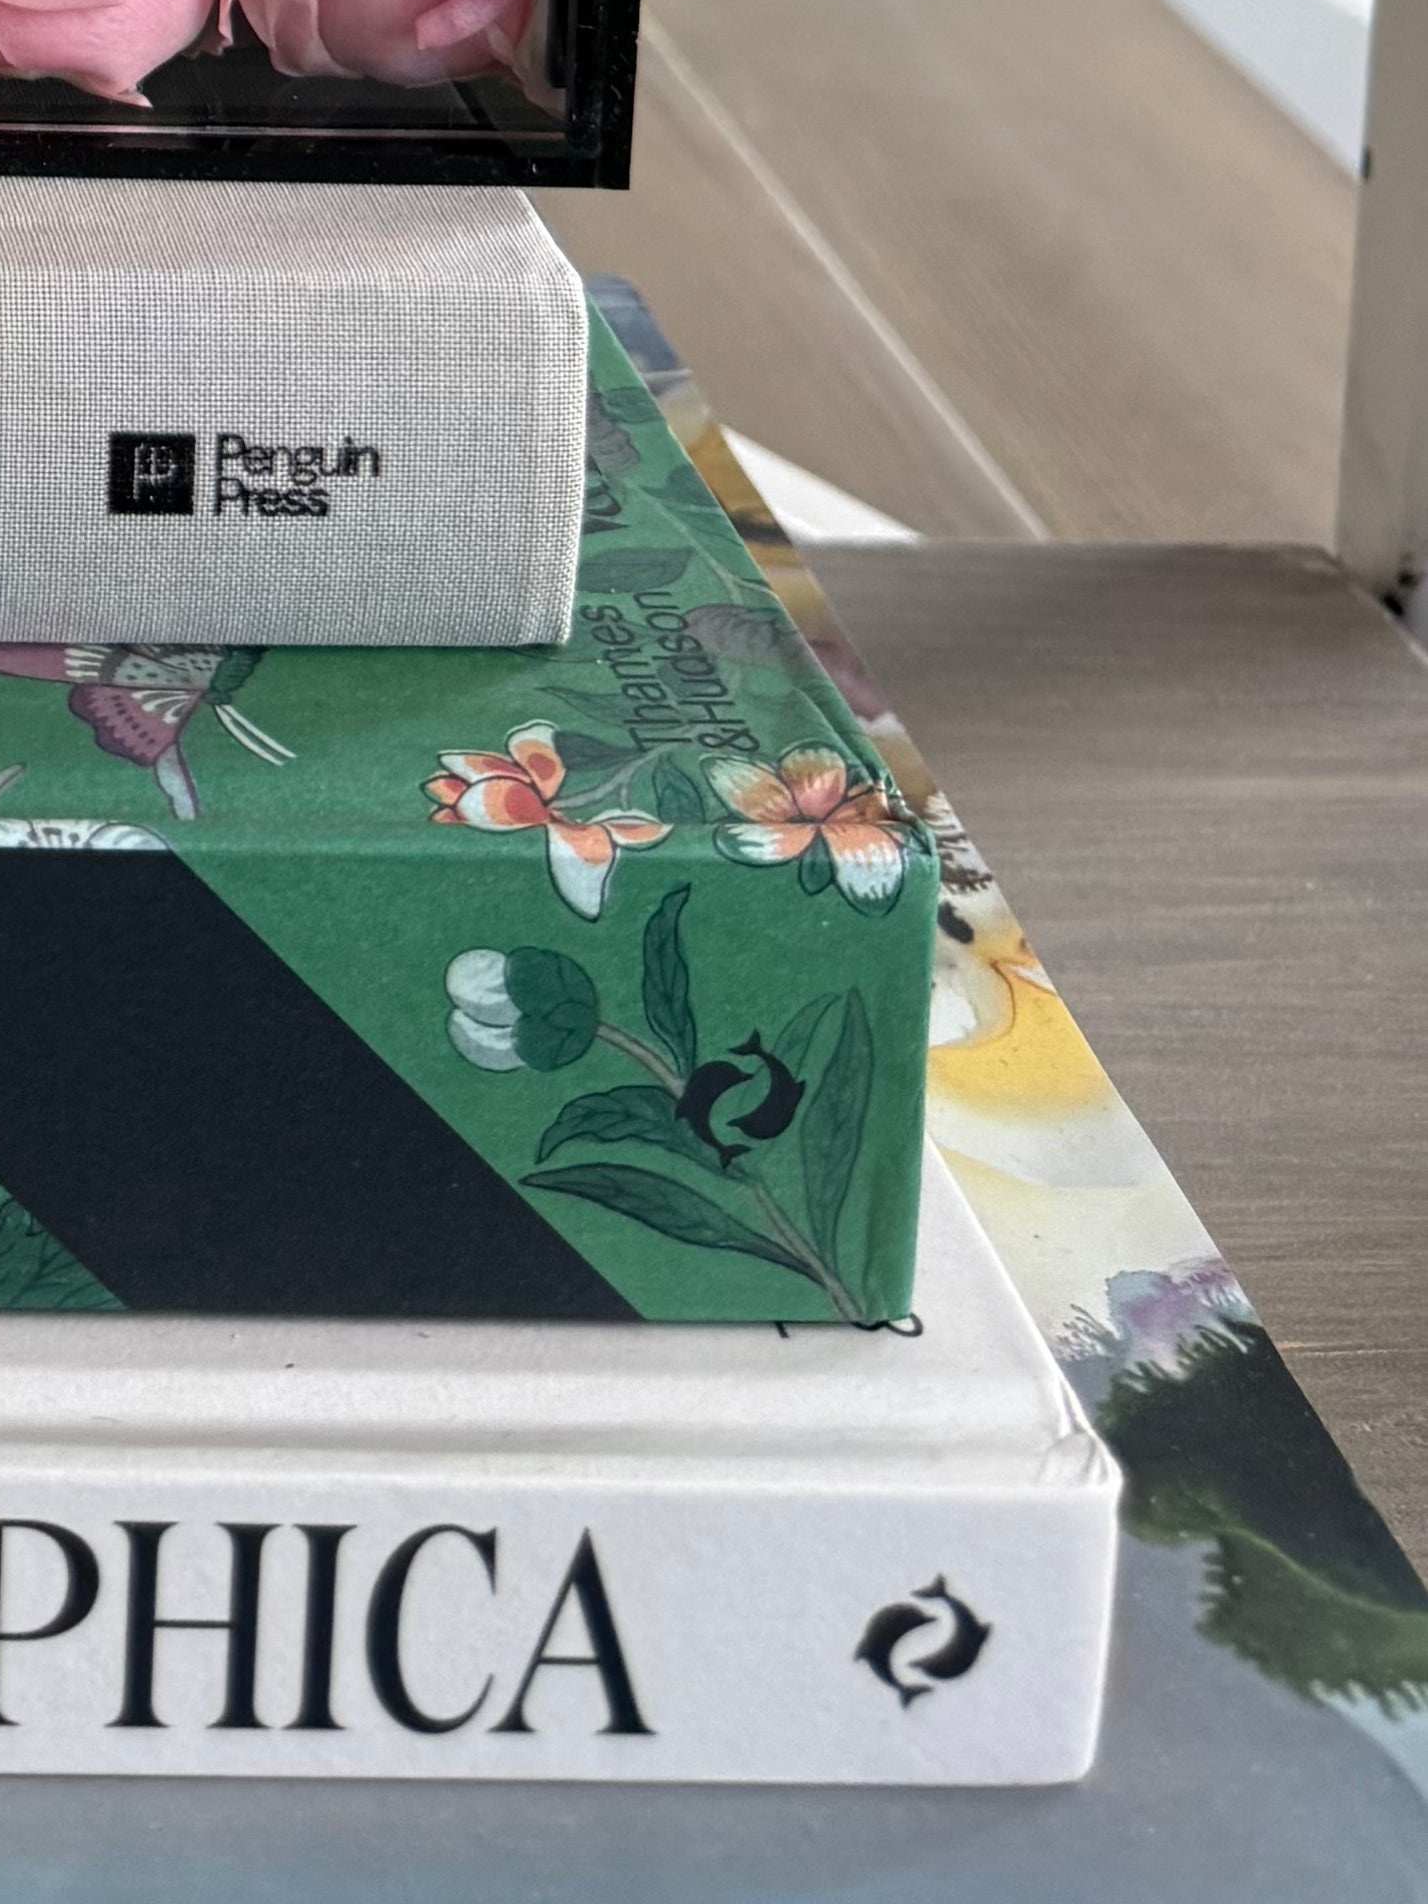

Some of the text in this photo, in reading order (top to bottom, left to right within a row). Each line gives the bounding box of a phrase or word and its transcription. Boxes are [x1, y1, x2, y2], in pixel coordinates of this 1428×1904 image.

[216, 432, 380, 487] Penguin
[215, 477, 331, 517] Press
[580, 604, 693, 753] Thames
